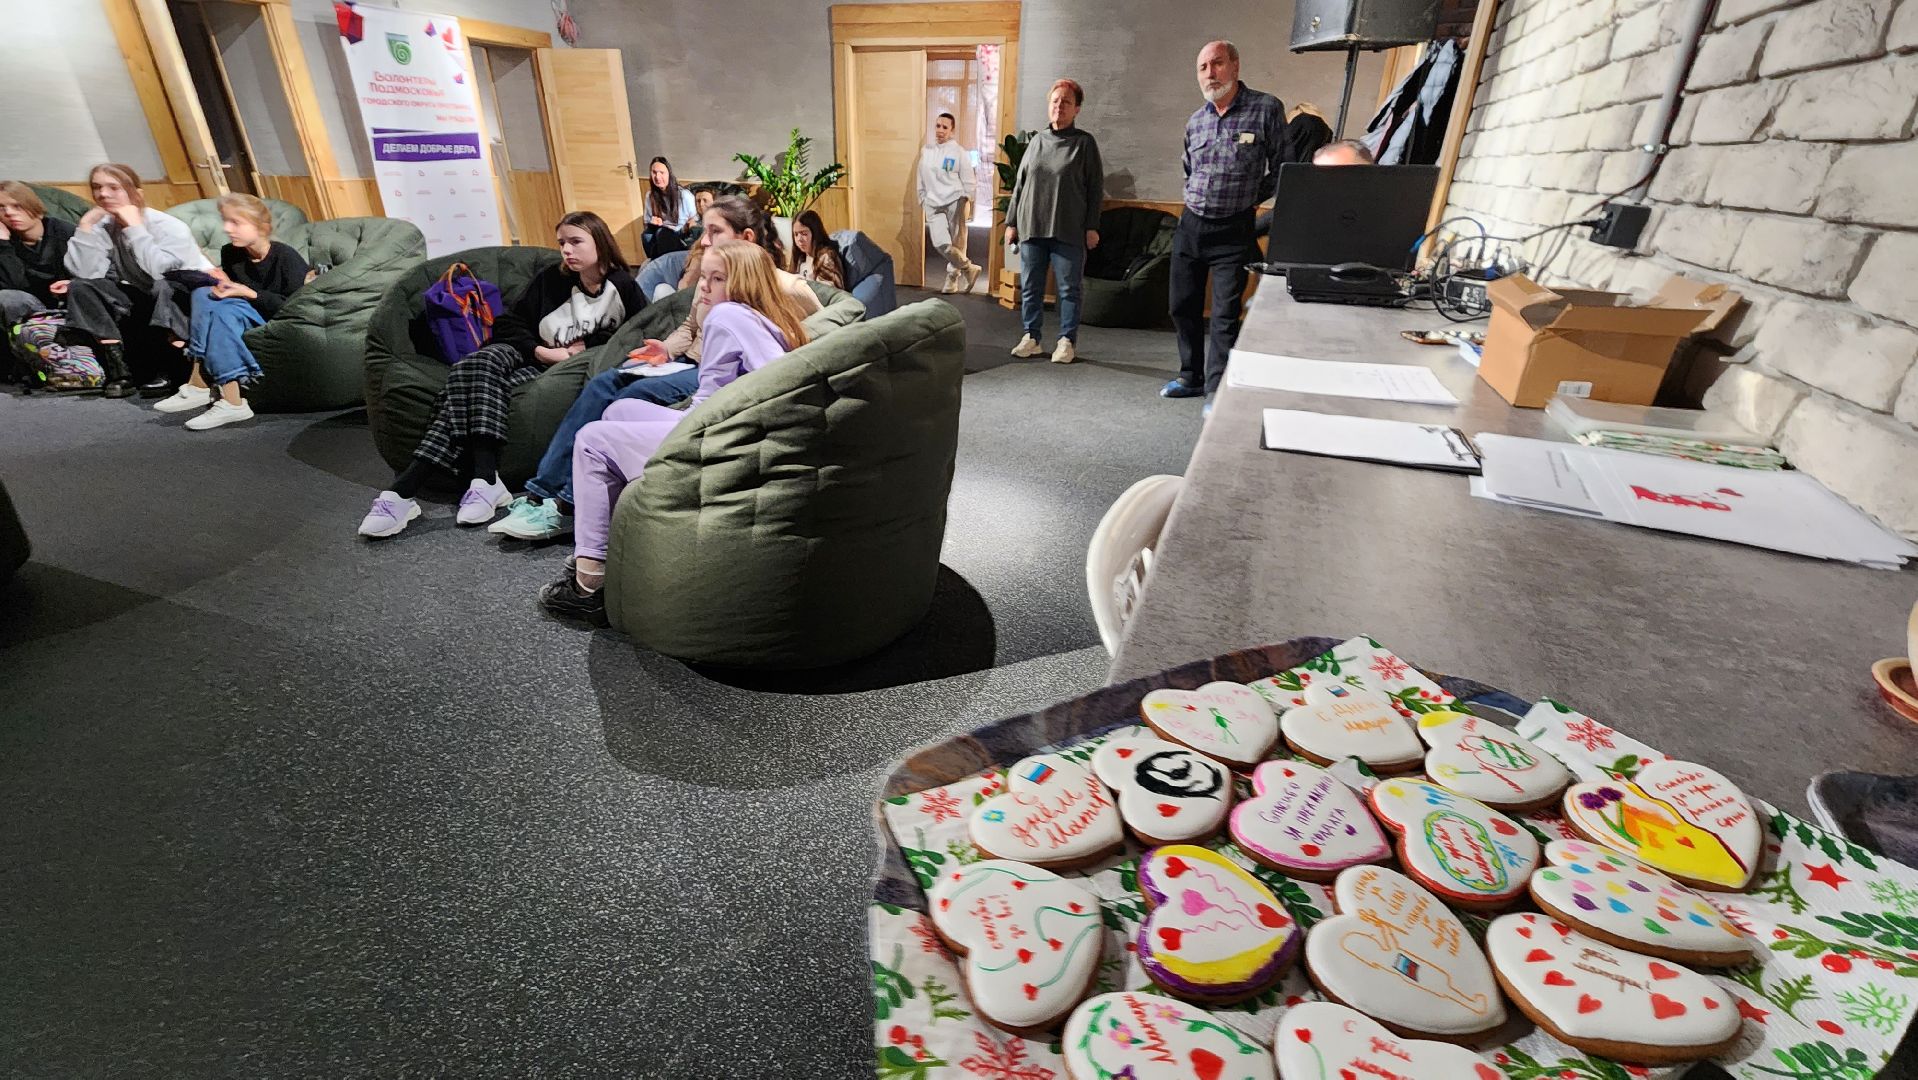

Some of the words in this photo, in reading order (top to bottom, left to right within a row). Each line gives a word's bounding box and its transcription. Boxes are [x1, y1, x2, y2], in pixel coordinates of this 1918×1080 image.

[383, 143, 418, 154] ДЕЛАЕМ
[420, 144, 453, 154] ДОБРЫЕ
[454, 145, 476, 154] ДЕЛА
